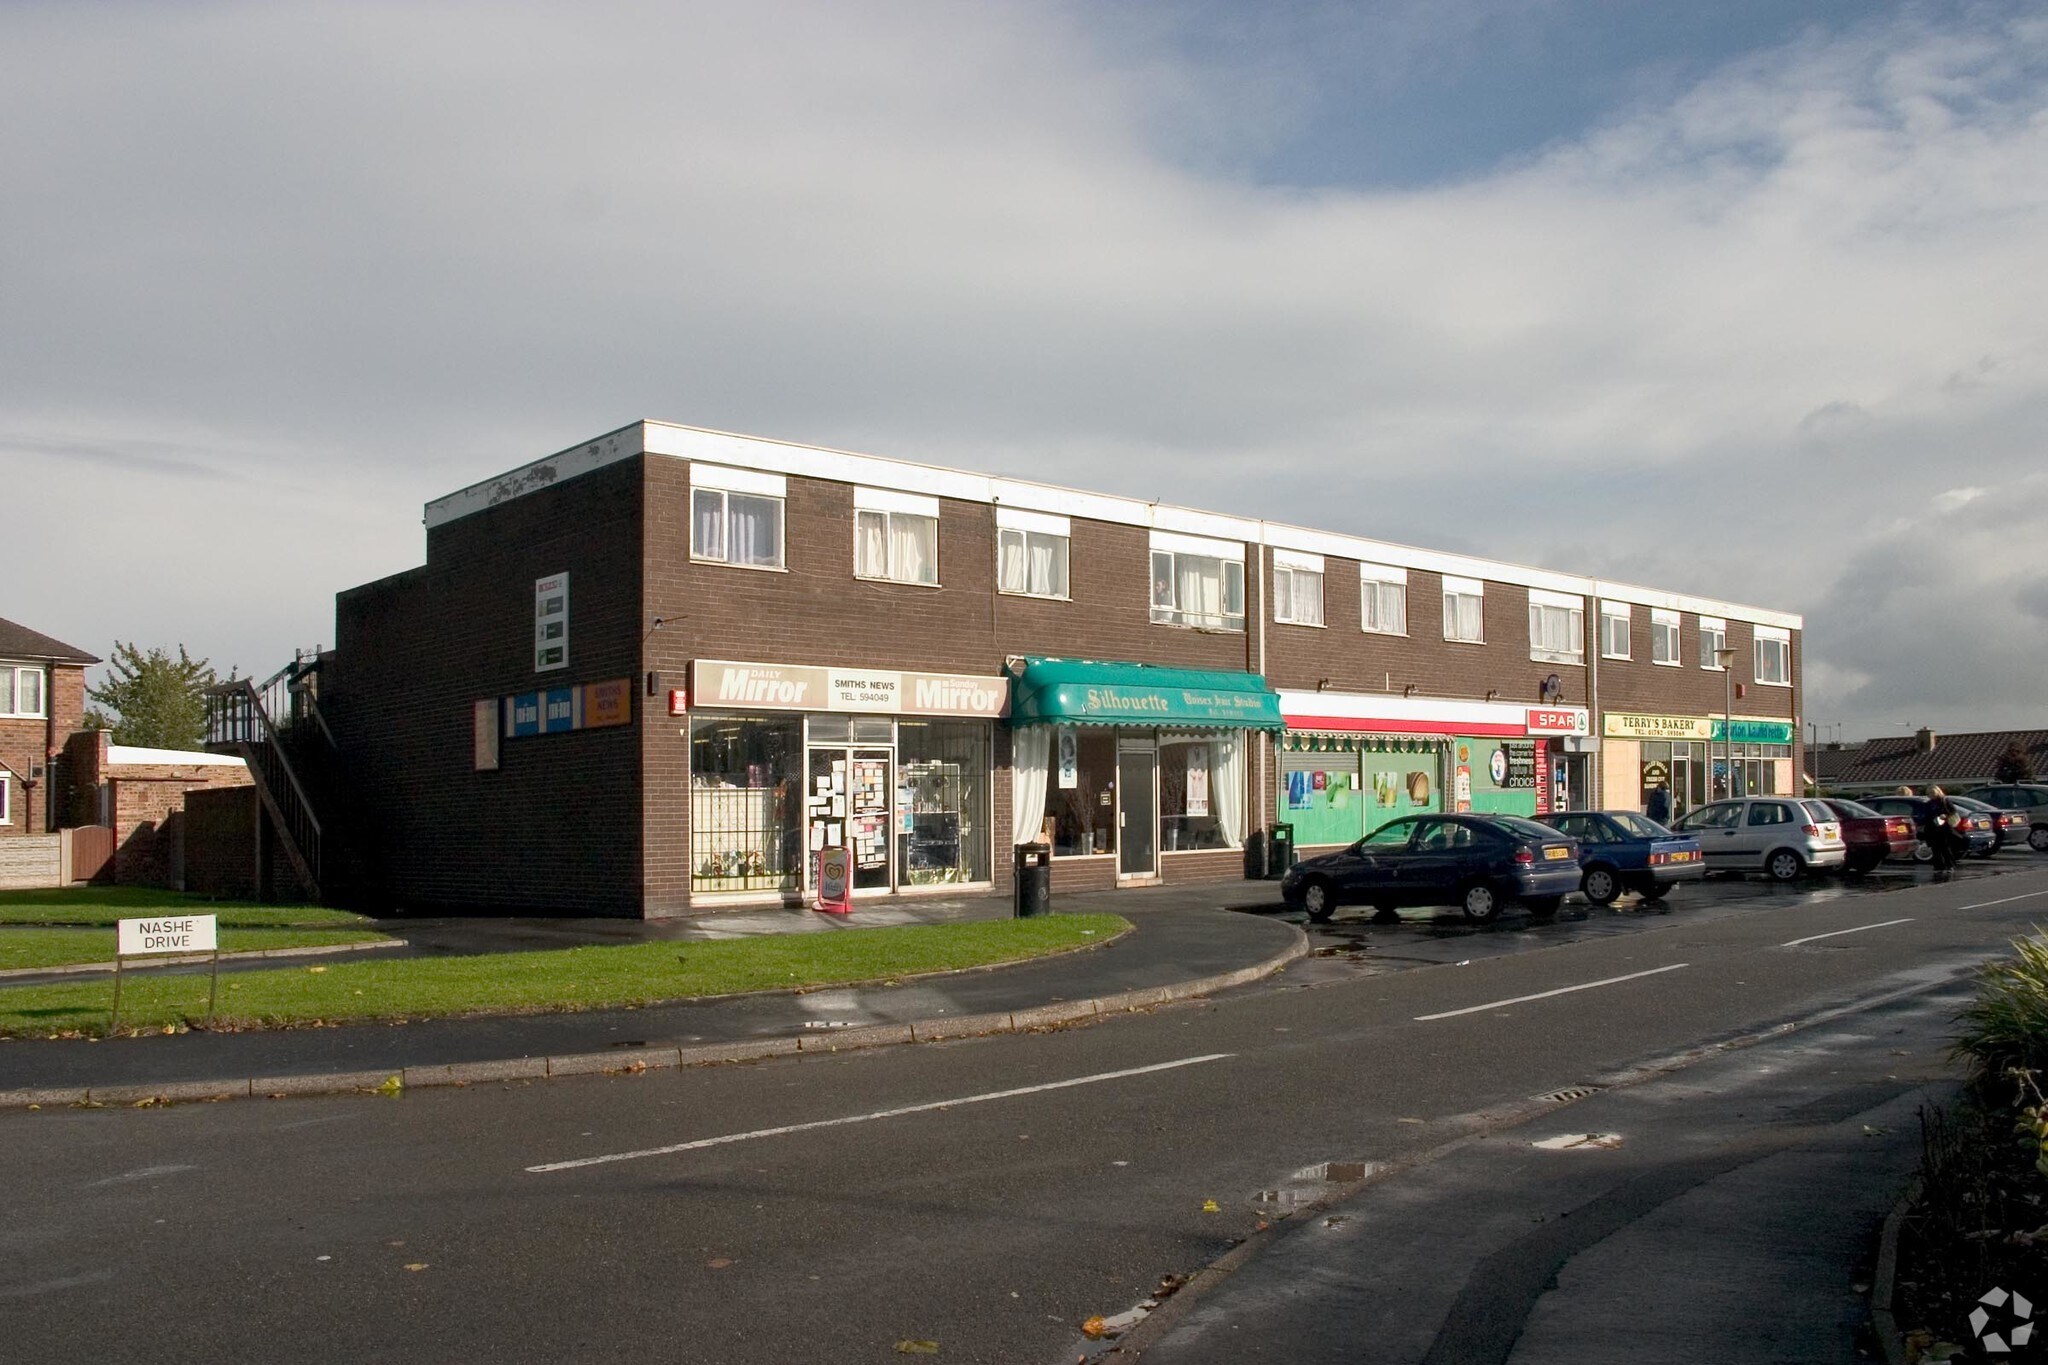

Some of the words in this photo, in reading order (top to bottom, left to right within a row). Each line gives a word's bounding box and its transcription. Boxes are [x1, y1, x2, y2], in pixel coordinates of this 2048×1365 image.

[751, 669, 781, 679] DAILY
[719, 668, 807, 703] Mirror
[834, 679, 866, 689] SMITHS
[870, 681, 895, 690] NEWS
[950, 679, 980, 689] Sunday
[859, 692, 889, 702] 594049
[915, 679, 998, 711] Mirror
[1087, 689, 1169, 712] Silhouette
[1182, 691, 1211, 705] Unisex
[1233, 696, 1262, 708] Studio
[1539, 714, 1575, 727] SPAR
[1623, 717, 1660, 730] TERRY'S
[1662, 718, 1696, 730] BAKERY
[1509, 775, 1534, 787] choice
[139, 920, 194, 934] NASHE
[144, 935, 191, 949] DRIVE
